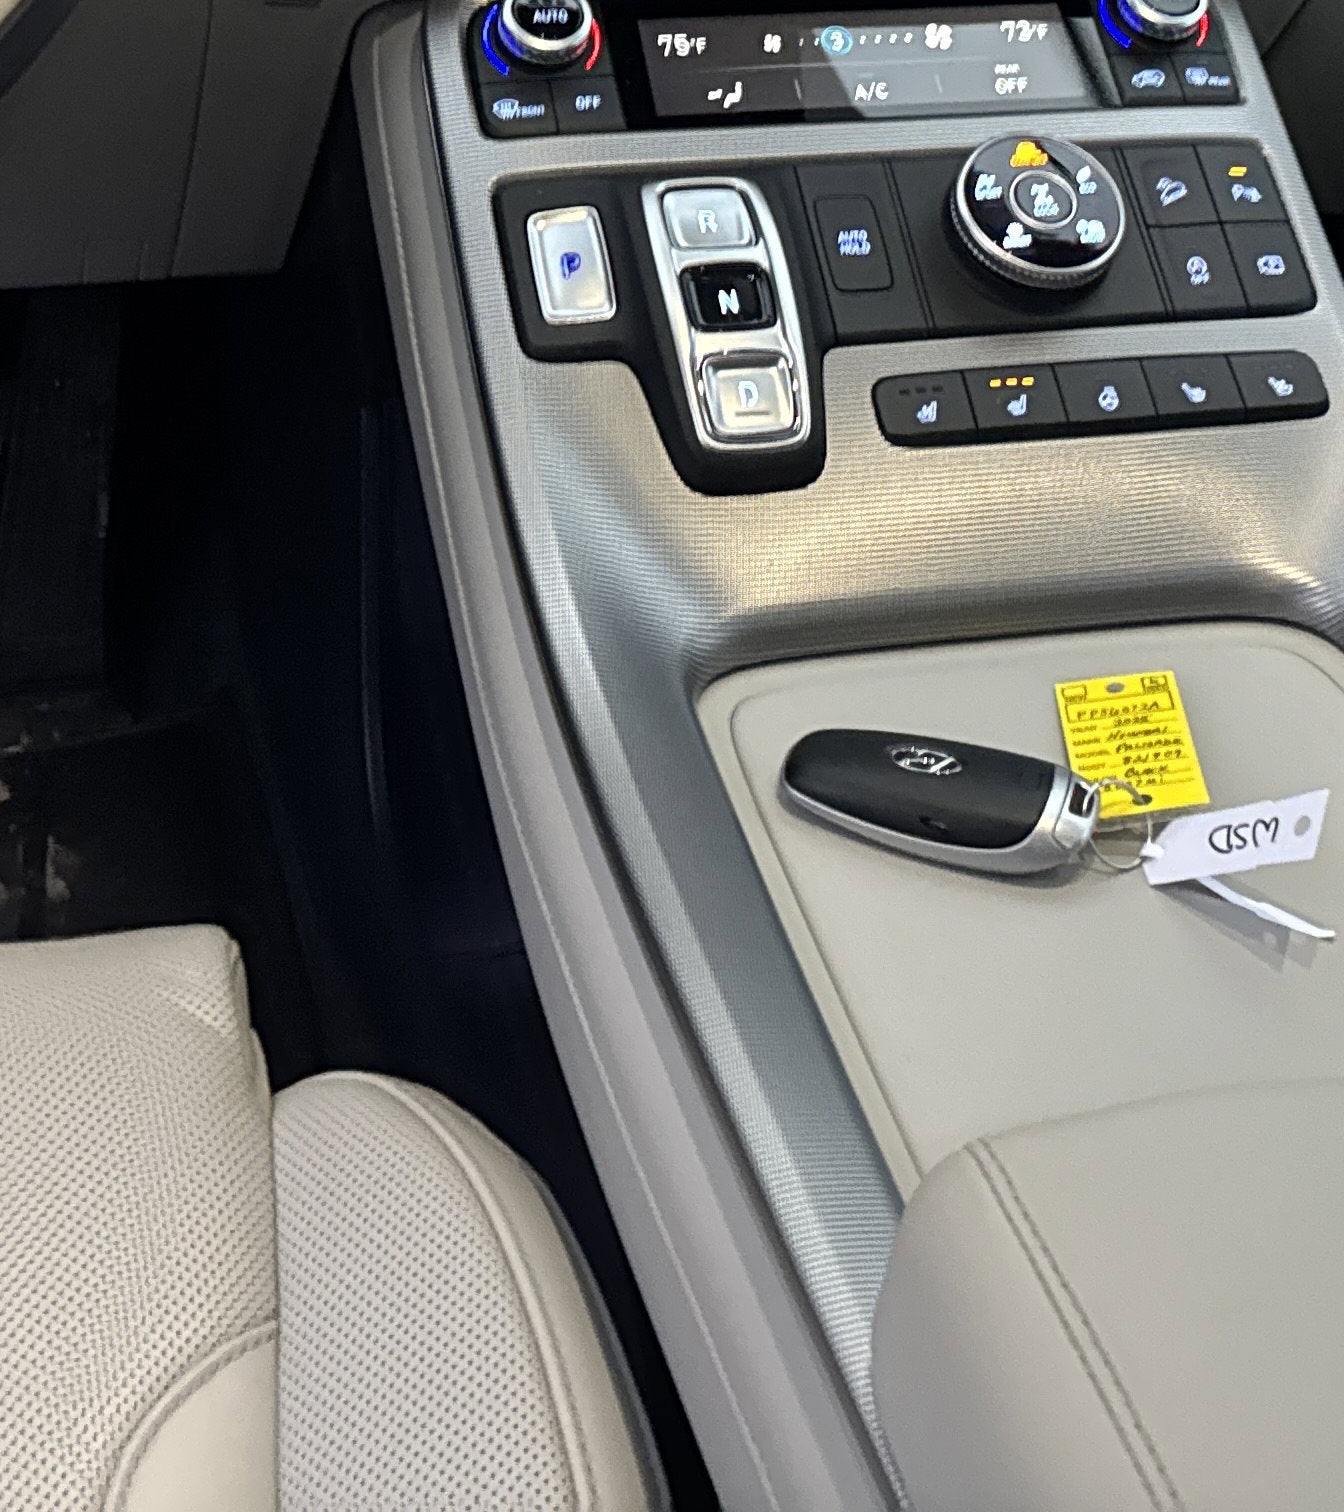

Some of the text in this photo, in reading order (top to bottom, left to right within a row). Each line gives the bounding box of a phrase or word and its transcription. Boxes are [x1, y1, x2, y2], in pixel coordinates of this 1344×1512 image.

[532, 7, 569, 24] AUTO
[854, 81, 889, 102] A/C
[994, 76, 1028, 95] OFF
[575, 95, 602, 112] OFF
[697, 209, 719, 235] R
[560, 251, 582, 280] P
[717, 287, 741, 315] N
[737, 380, 760, 408] D
